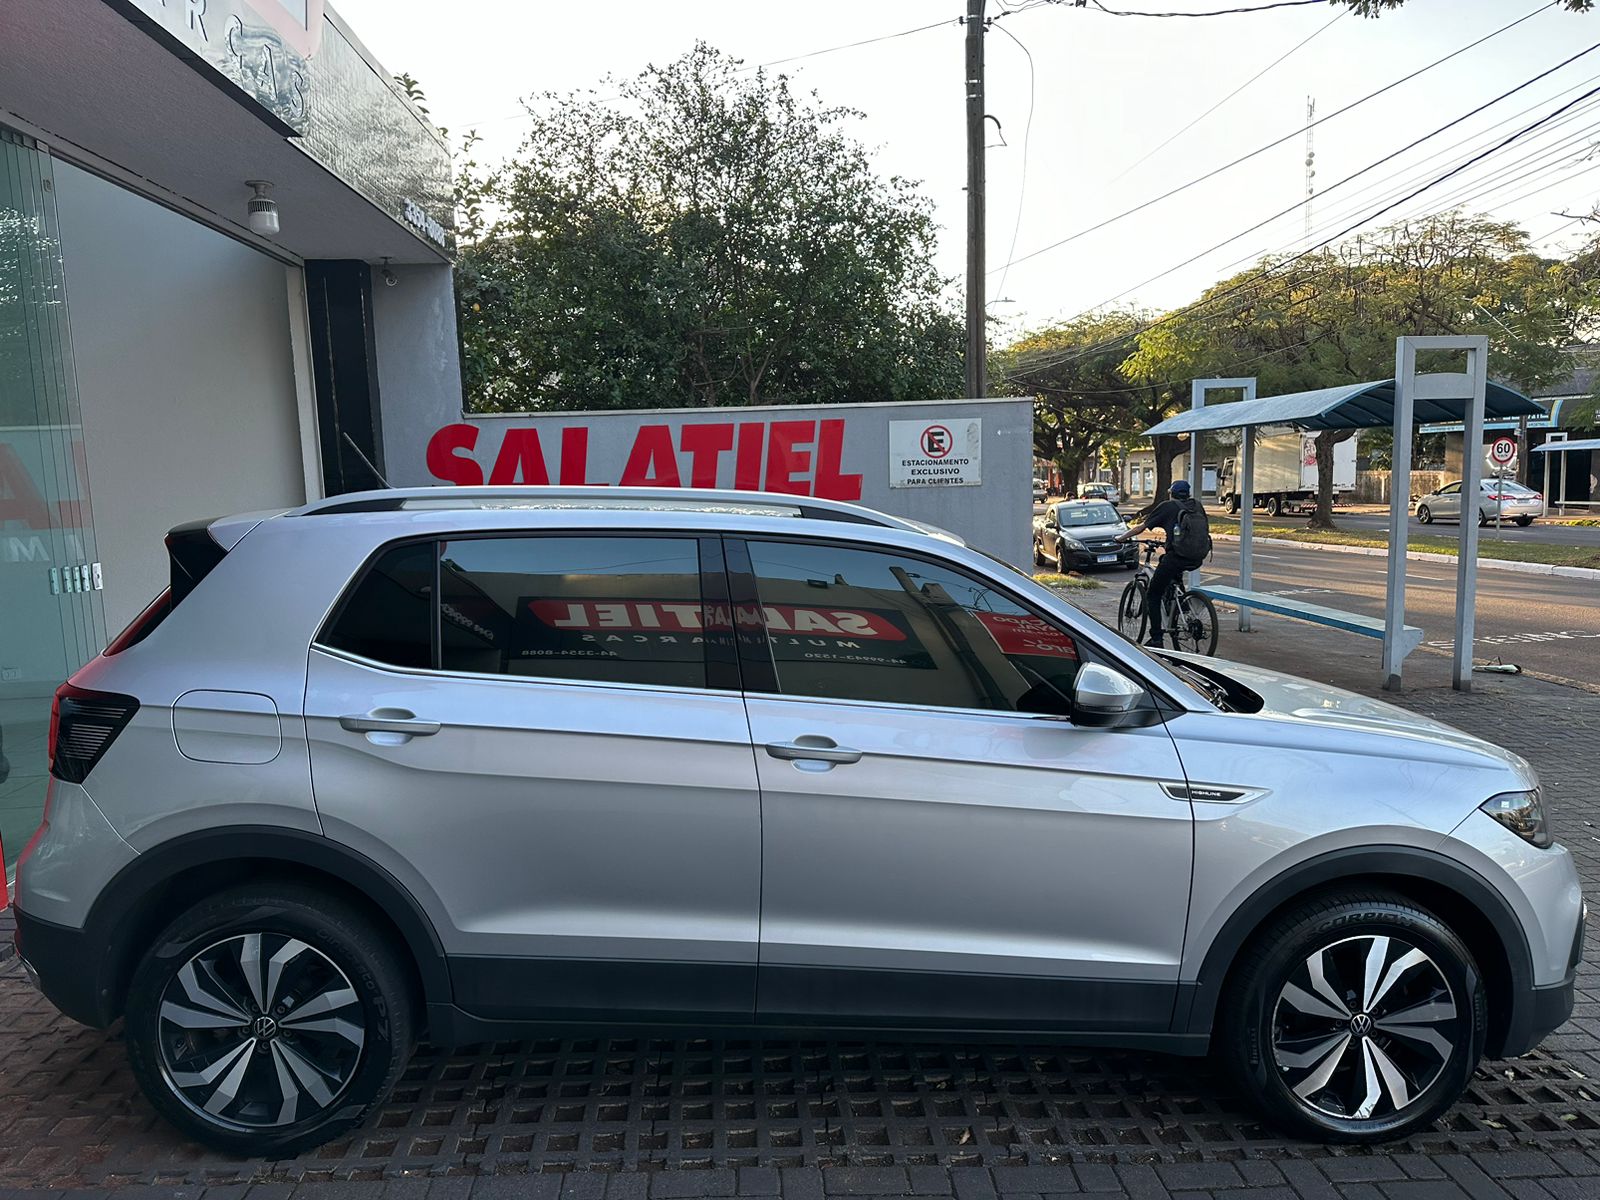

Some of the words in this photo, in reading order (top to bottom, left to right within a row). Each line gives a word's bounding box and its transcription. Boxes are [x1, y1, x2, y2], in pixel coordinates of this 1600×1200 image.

[1497, 443, 1510, 454] 60
[426, 418, 864, 502] SALATIEL
[902, 458, 969, 467] ESTACIONAMENTO
[928, 477, 964, 485] CLIENTES
